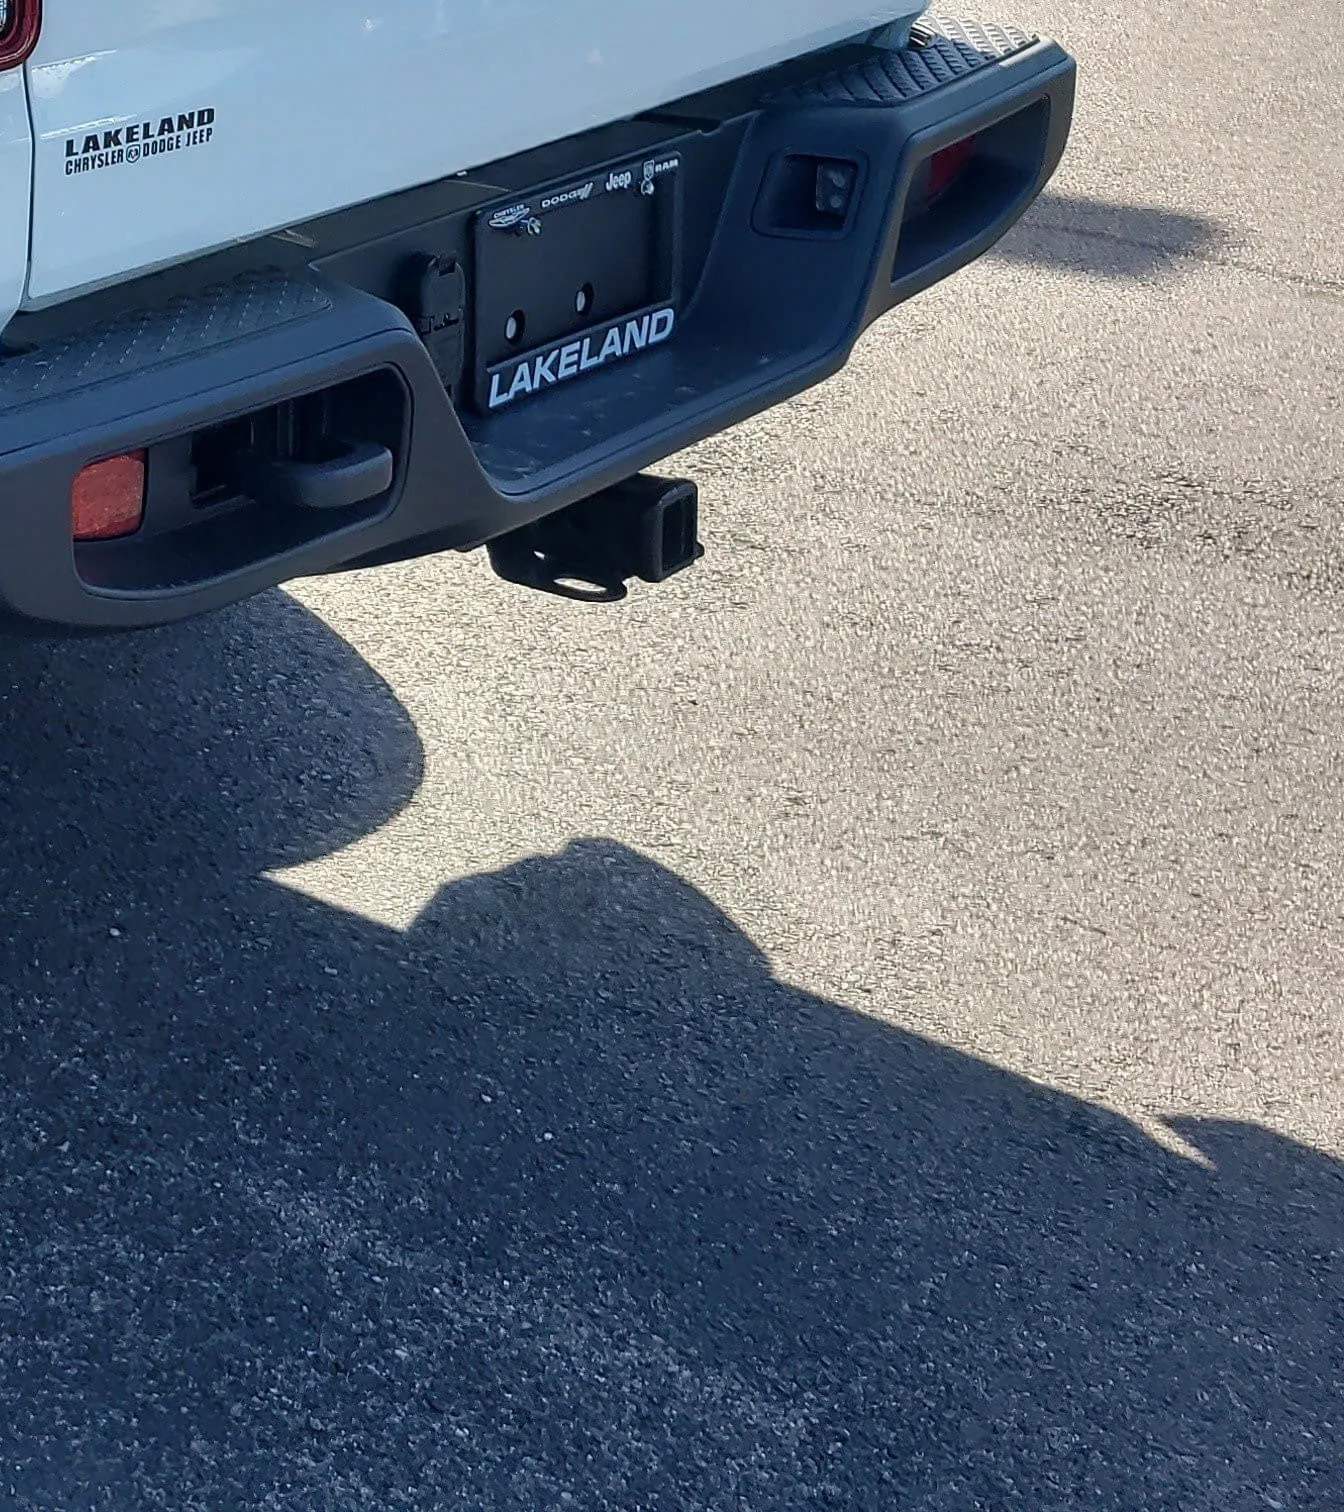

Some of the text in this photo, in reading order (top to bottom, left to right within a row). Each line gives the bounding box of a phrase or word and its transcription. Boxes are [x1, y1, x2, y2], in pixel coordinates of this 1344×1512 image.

[65, 107, 215, 157] LAKELAND
[65, 127, 213, 176] CHRYSLER DODGE JEEP
[606, 170, 632, 191] Jeep
[655, 158, 678, 173] RAM
[488, 307, 675, 409] LAKELAND
